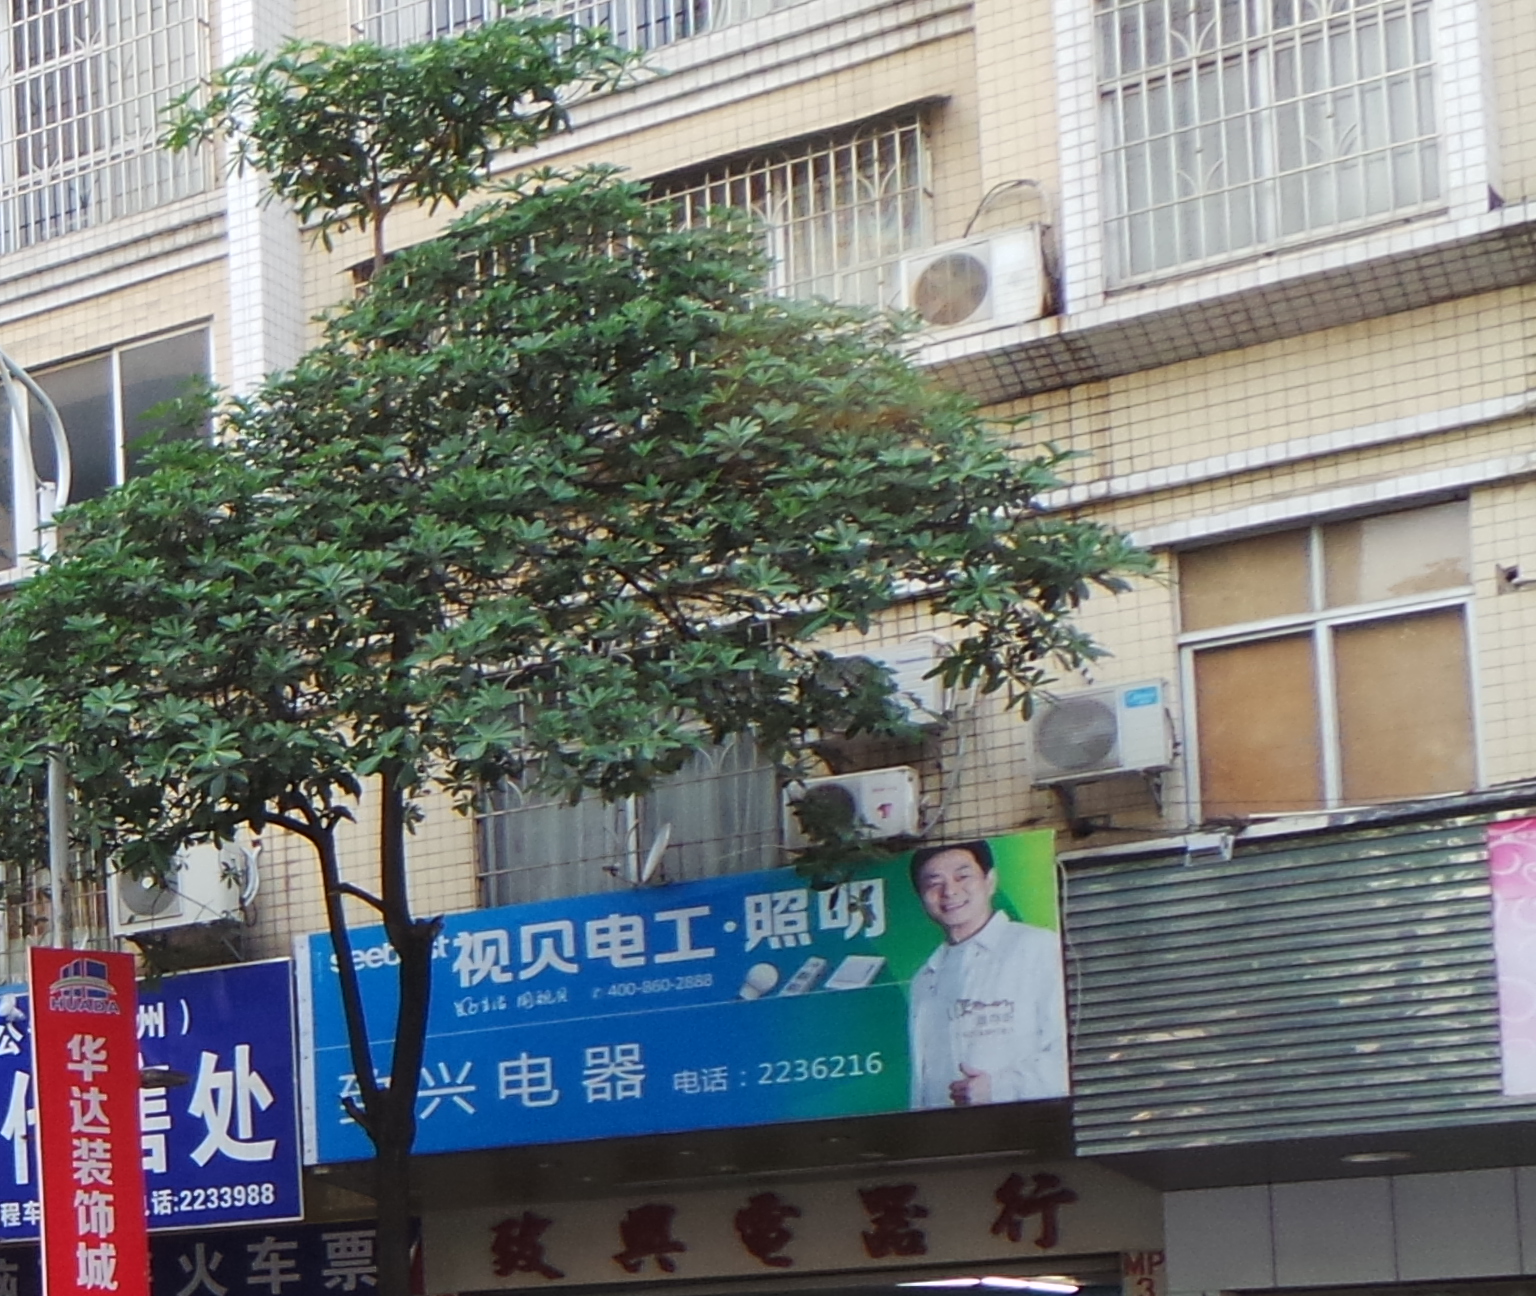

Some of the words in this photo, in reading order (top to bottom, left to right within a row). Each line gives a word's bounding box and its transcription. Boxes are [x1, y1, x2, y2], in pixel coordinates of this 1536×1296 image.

[330, 936, 449, 974] seebst
[607, 973, 714, 998] 400-860-2888
[49, 995, 121, 1015] HUADA
[66, 1033, 119, 1292] 华达装饰城
[142, 1182, 276, 1218] 话:2233988
